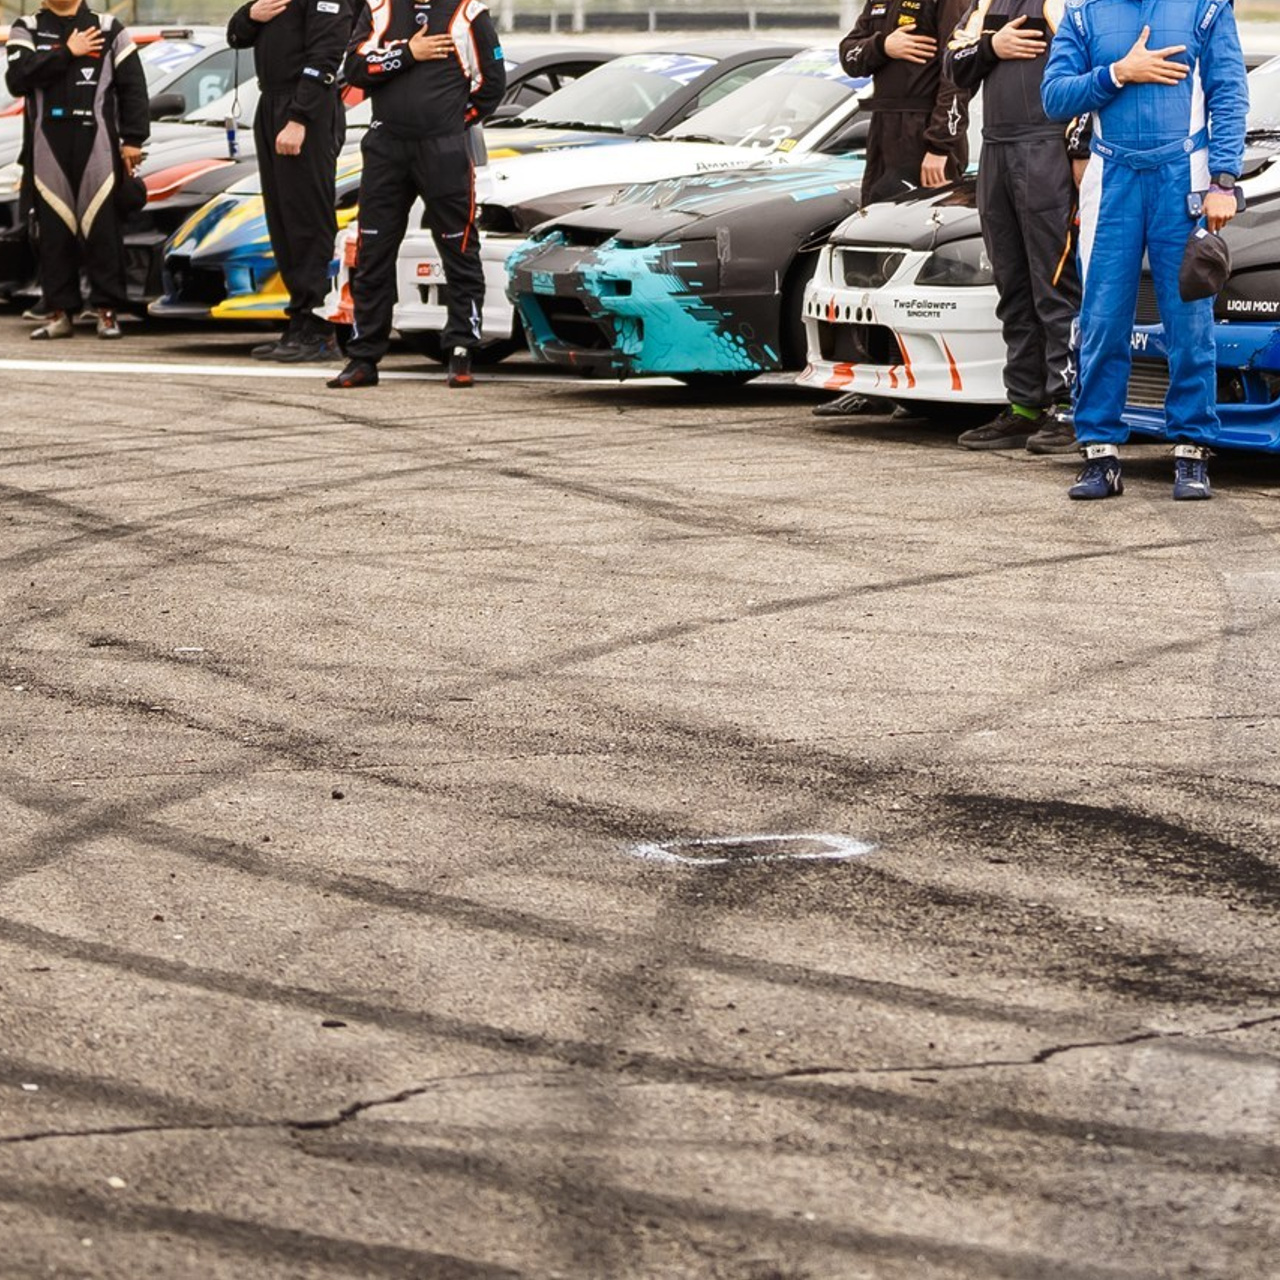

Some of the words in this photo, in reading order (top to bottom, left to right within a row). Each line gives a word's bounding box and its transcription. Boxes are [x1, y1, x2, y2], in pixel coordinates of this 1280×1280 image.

[893, 299, 958, 310] TwoFollowers
[1227, 300, 1252, 311] LIQUI
[1252, 300, 1280, 312] MOLY
